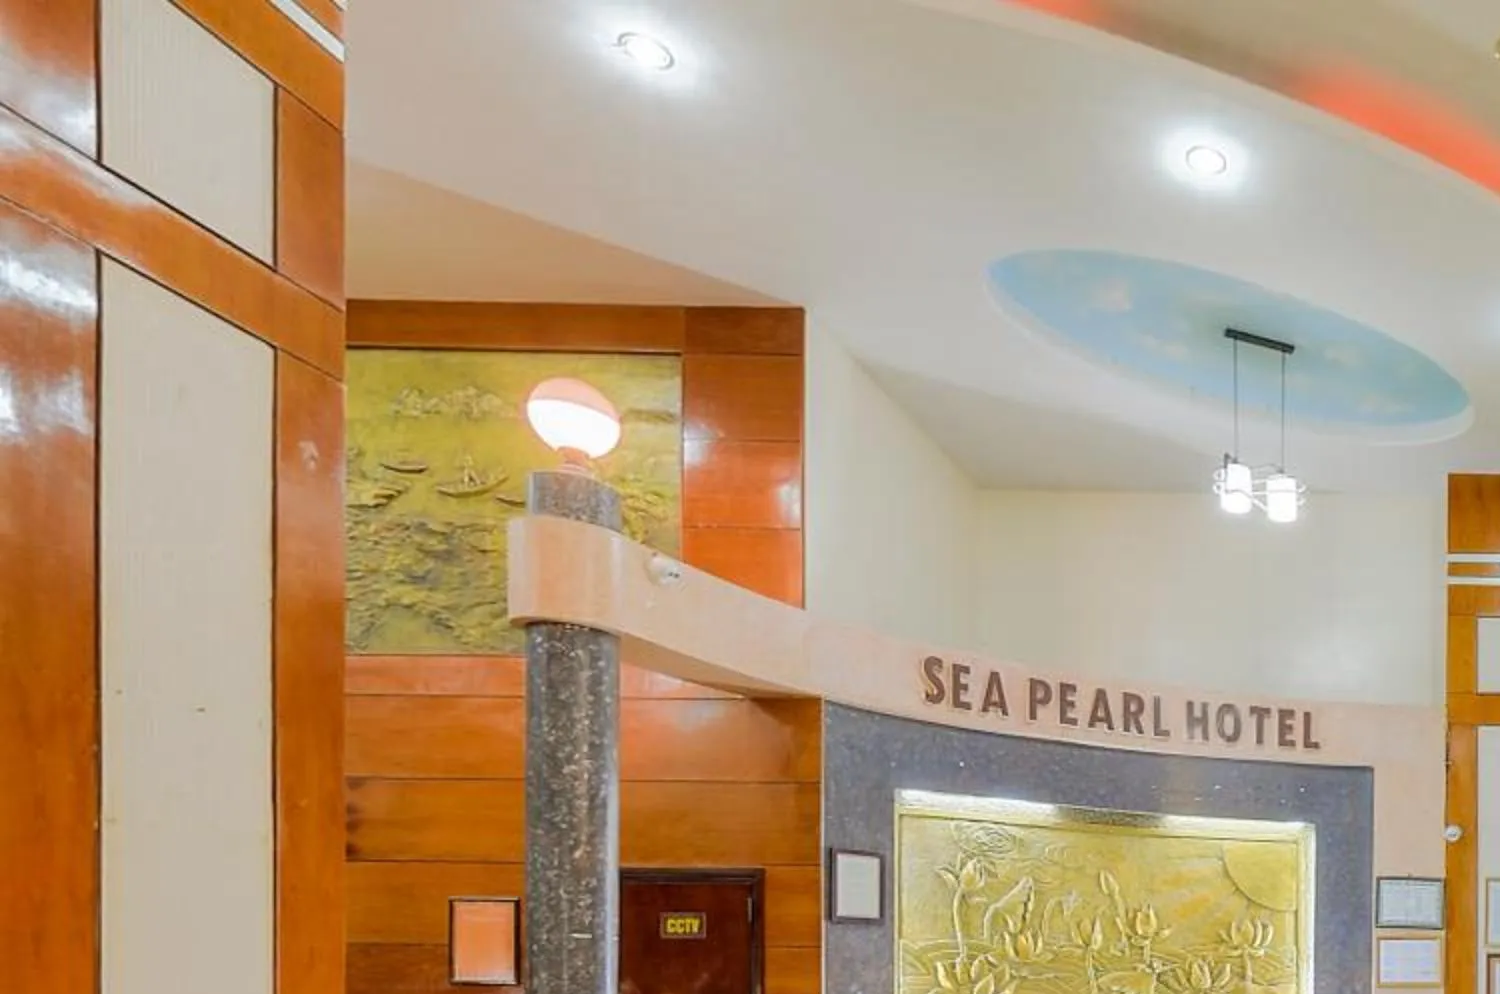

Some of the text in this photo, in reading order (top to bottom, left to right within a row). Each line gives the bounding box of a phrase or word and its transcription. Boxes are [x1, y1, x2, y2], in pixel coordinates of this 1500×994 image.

[922, 655, 1321, 750] SEA PEARL HOTEL
[667, 918, 700, 934] CCTV
